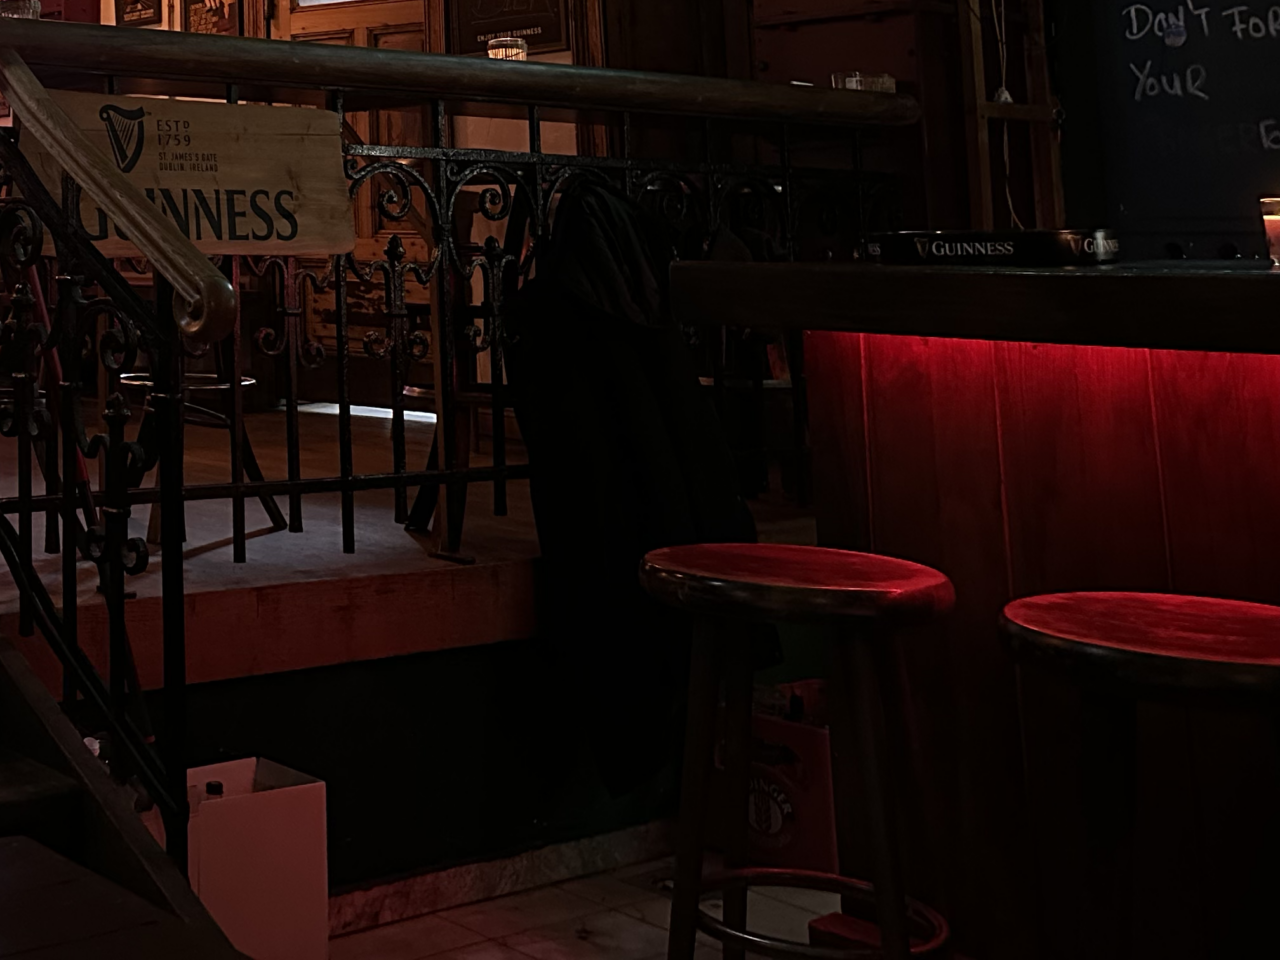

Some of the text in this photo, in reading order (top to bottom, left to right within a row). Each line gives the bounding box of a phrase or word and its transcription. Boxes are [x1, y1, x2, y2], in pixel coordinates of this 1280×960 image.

[512, 26, 542, 37] GUINNESS
[1129, 59, 1209, 103] YOUR
[158, 134, 191, 146] 1759
[202, 153, 218, 163] GATE
[189, 163, 218, 173] IRELAND
[932, 241, 1014, 256] GUINNESS
